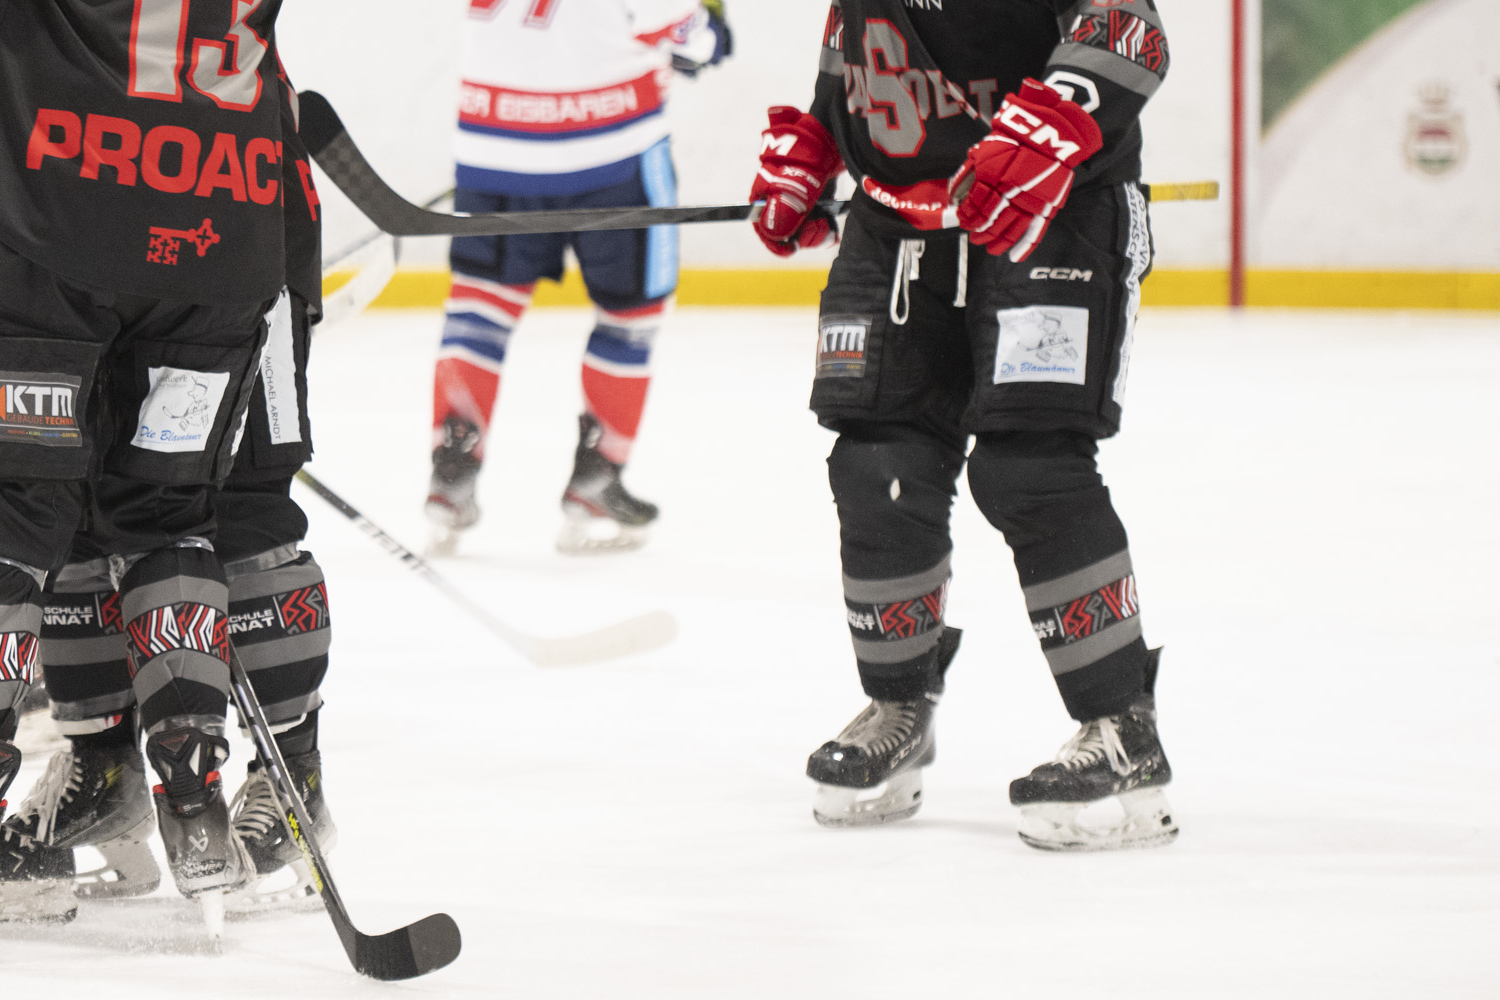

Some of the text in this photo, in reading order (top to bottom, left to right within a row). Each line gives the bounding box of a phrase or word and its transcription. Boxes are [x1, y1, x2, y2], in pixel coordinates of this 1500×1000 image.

[1030, 267, 1092, 282] CCM
[6, 384, 73, 417] KTM
[264, 356, 281, 440] MICHAEL ARNDT
[140, 425, 156, 439] Die
